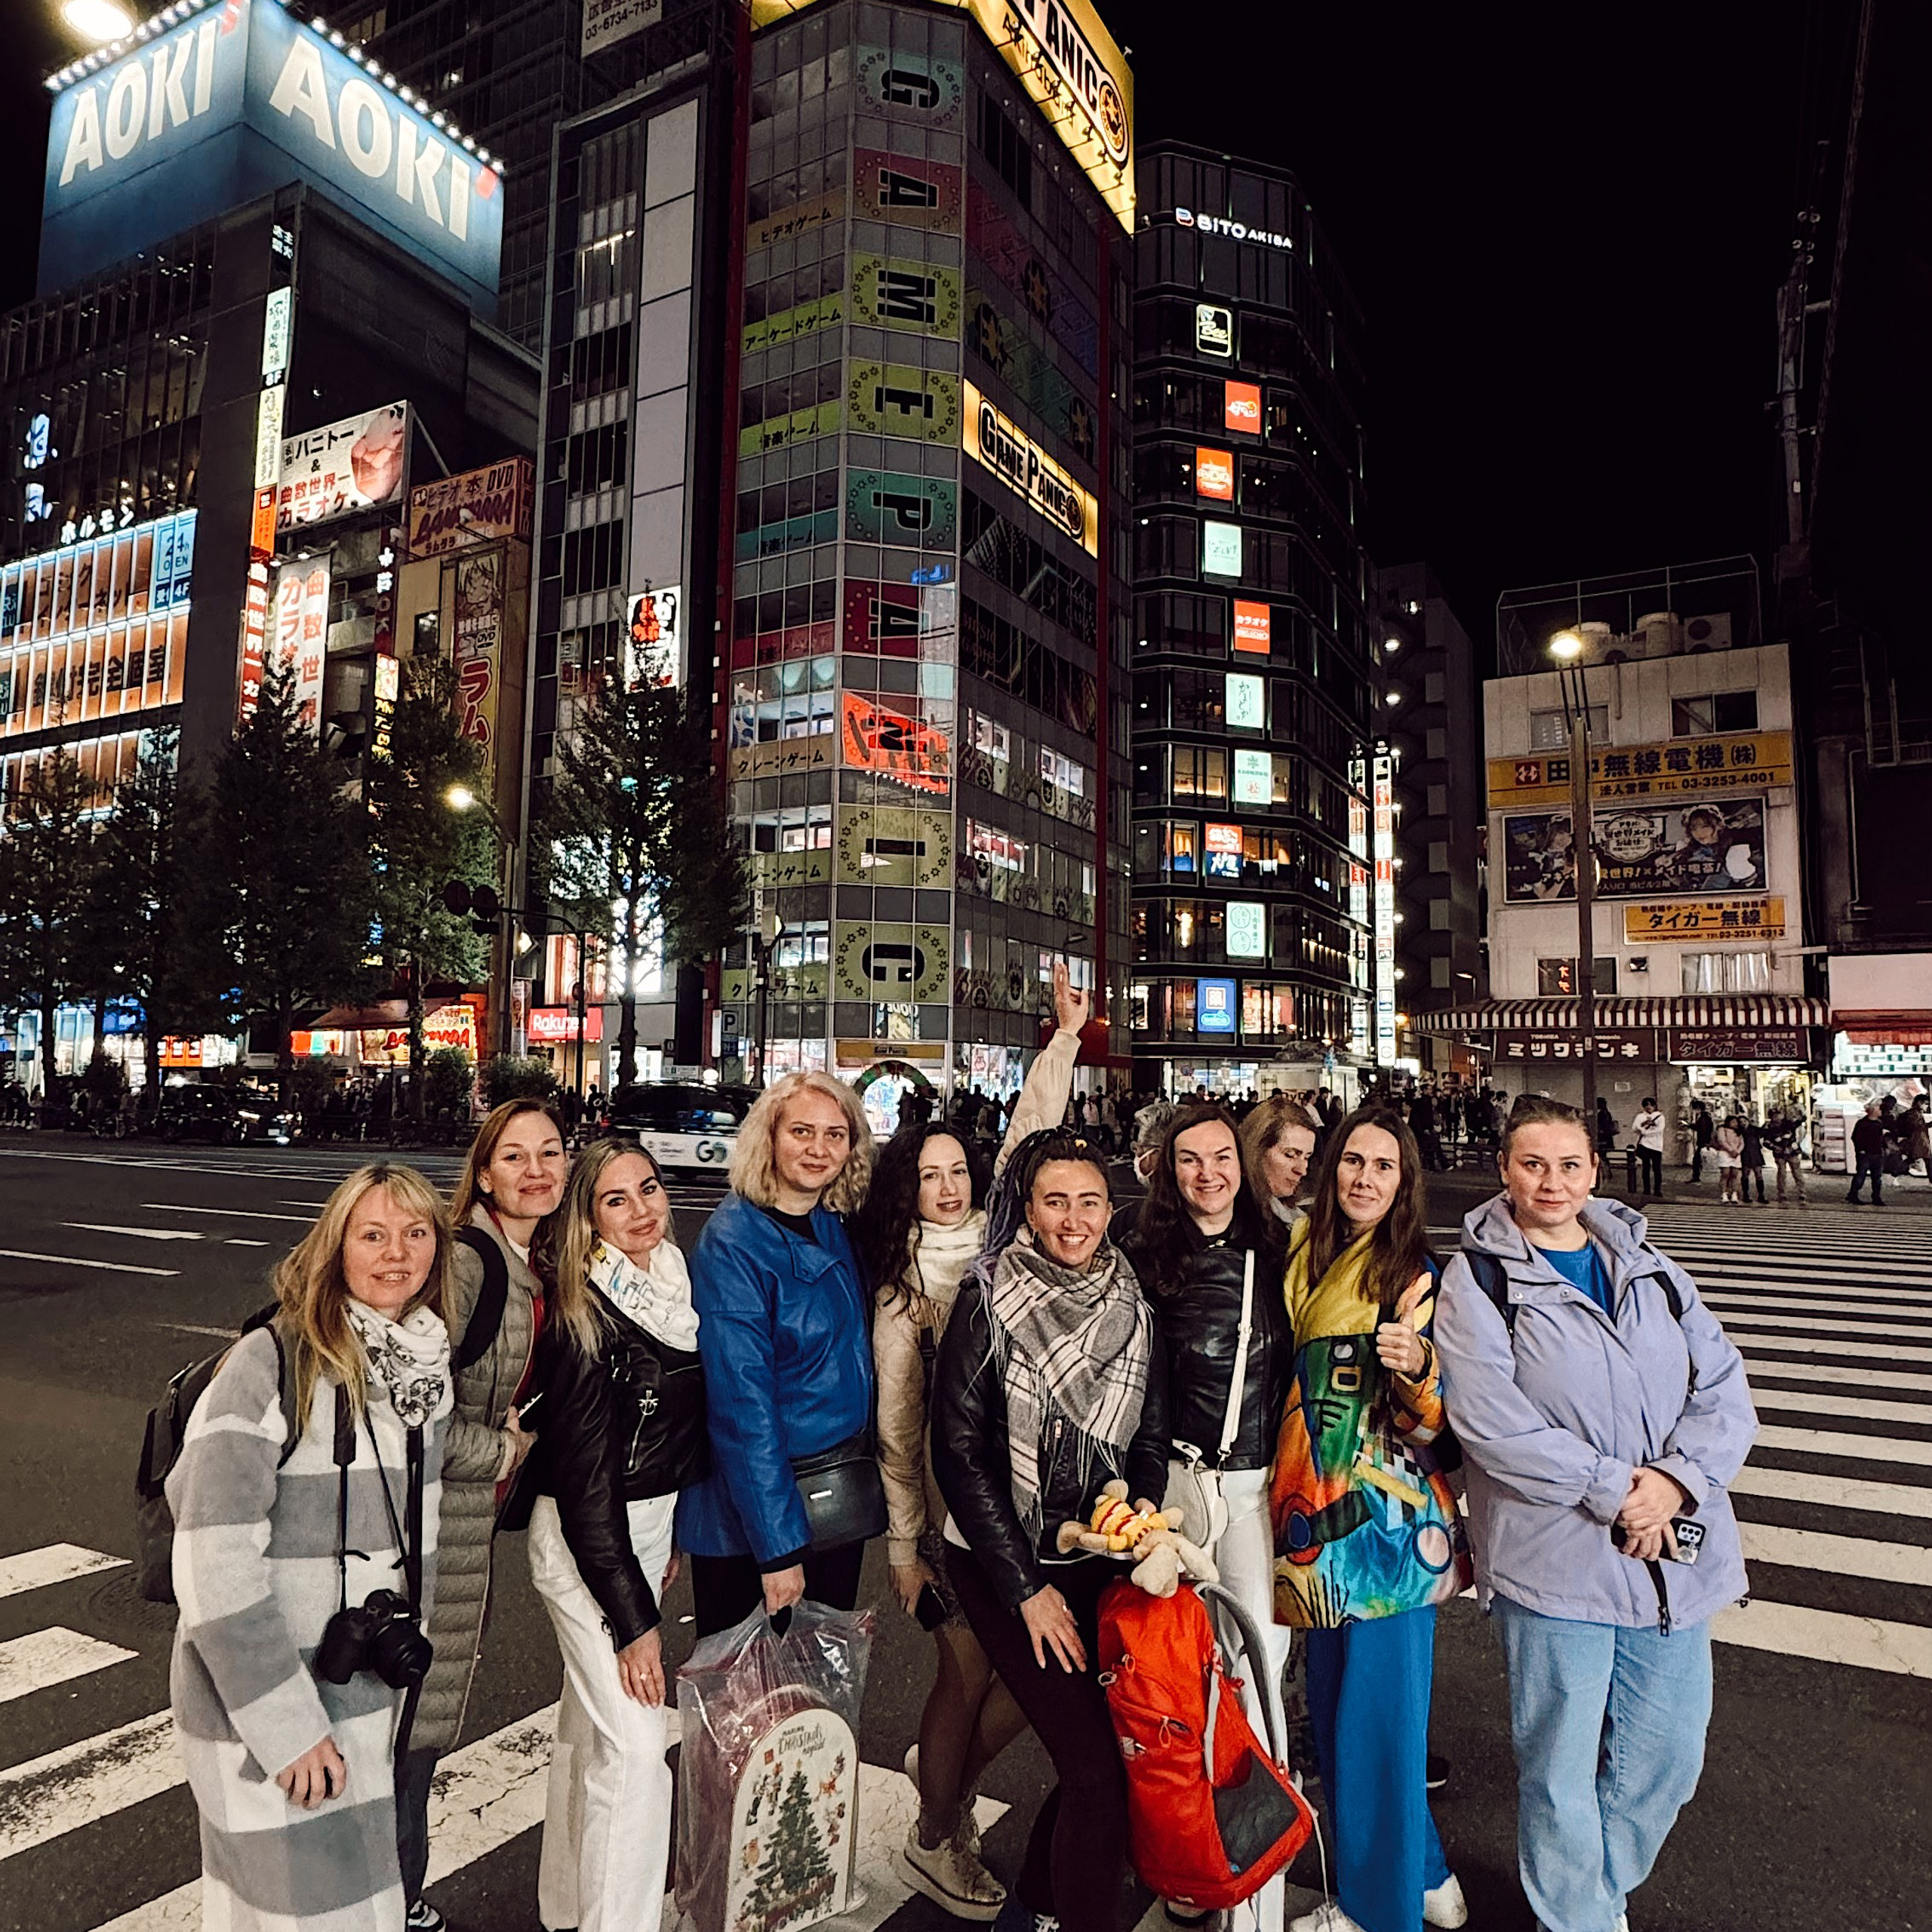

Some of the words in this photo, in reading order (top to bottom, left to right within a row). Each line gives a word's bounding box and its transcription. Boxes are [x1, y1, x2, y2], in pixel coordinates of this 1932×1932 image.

[59, 18, 217, 188] AOKI
[269, 34, 471, 242] AOKI
[1197, 213, 1246, 238] BITO
[1247, 229, 1293, 249] AKIBA
[746, 309, 841, 350] アーケードゲーム
[266, 371, 281, 386] 8F
[296, 430, 354, 459] ハニトー
[312, 459, 321, 472] &
[280, 473, 350, 505] 曲数世界一
[487, 465, 514, 492] DVD
[278, 491, 349, 528] カラオケ
[61, 505, 134, 543] ホルモン
[163, 559, 188, 571] OEN
[174, 582, 189, 597] 4F
[1235, 615, 1268, 627] カラオケ
[459, 659, 491, 745] ラム
[739, 749, 823, 774] クレーンゲーム
[1658, 780, 1678, 790] TEL
[1681, 772, 1774, 790] 03-3253-4001
[747, 865, 821, 883] レーンゲーム
[1649, 909, 1761, 928] タイガー無線
[732, 982, 818, 997] クレゲーム
[724, 1013, 736, 1031] P
[1679, 1041, 1798, 1057] タイガー無線
